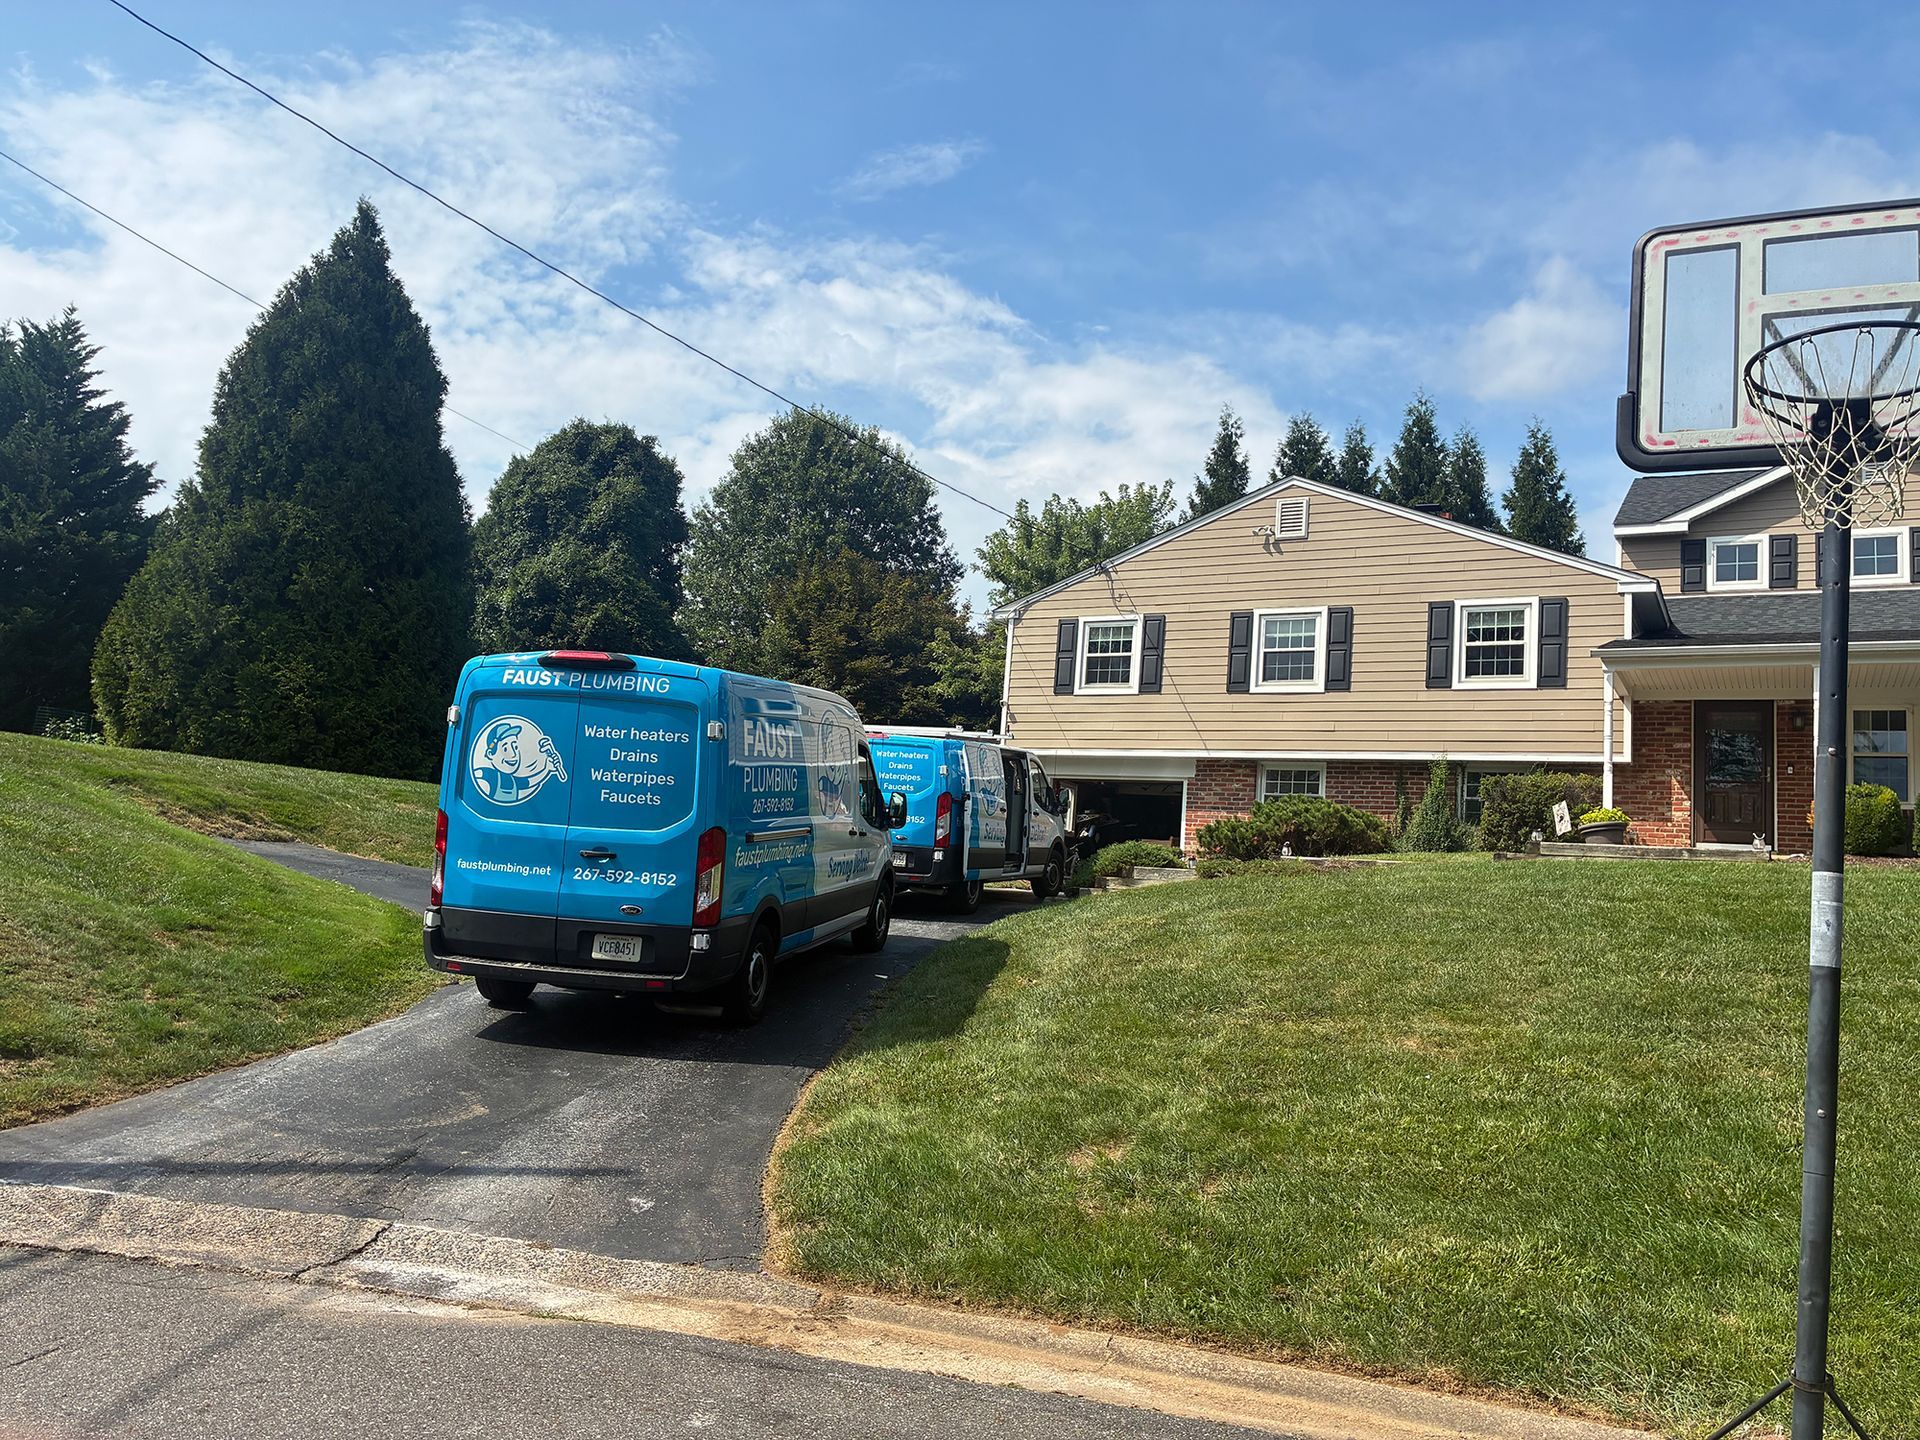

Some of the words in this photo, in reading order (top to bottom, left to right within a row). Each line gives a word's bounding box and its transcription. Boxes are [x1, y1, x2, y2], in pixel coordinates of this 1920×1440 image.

[502, 669, 565, 686] FAUST
[568, 672, 670, 693] PLUMBING
[584, 724, 627, 739] Water
[630, 727, 689, 743] heaters
[743, 719, 795, 759] FAUST
[610, 748, 658, 763] Drains
[876, 750, 898, 758] Water
[899, 751, 929, 760] heaters
[888, 761, 913, 770] Drains
[591, 768, 675, 787] Waterpipes
[743, 767, 798, 793] PLUMBING
[878, 771, 921, 782] Waterpipes
[883, 782, 914, 791] Faucets
[600, 789, 661, 805] Faucets
[752, 798, 795, 814] 267-592-8152
[735, 840, 808, 868] faustplumbing.net
[457, 858, 551, 876] faustplumbing.net
[573, 867, 677, 887] 267-592-8152
